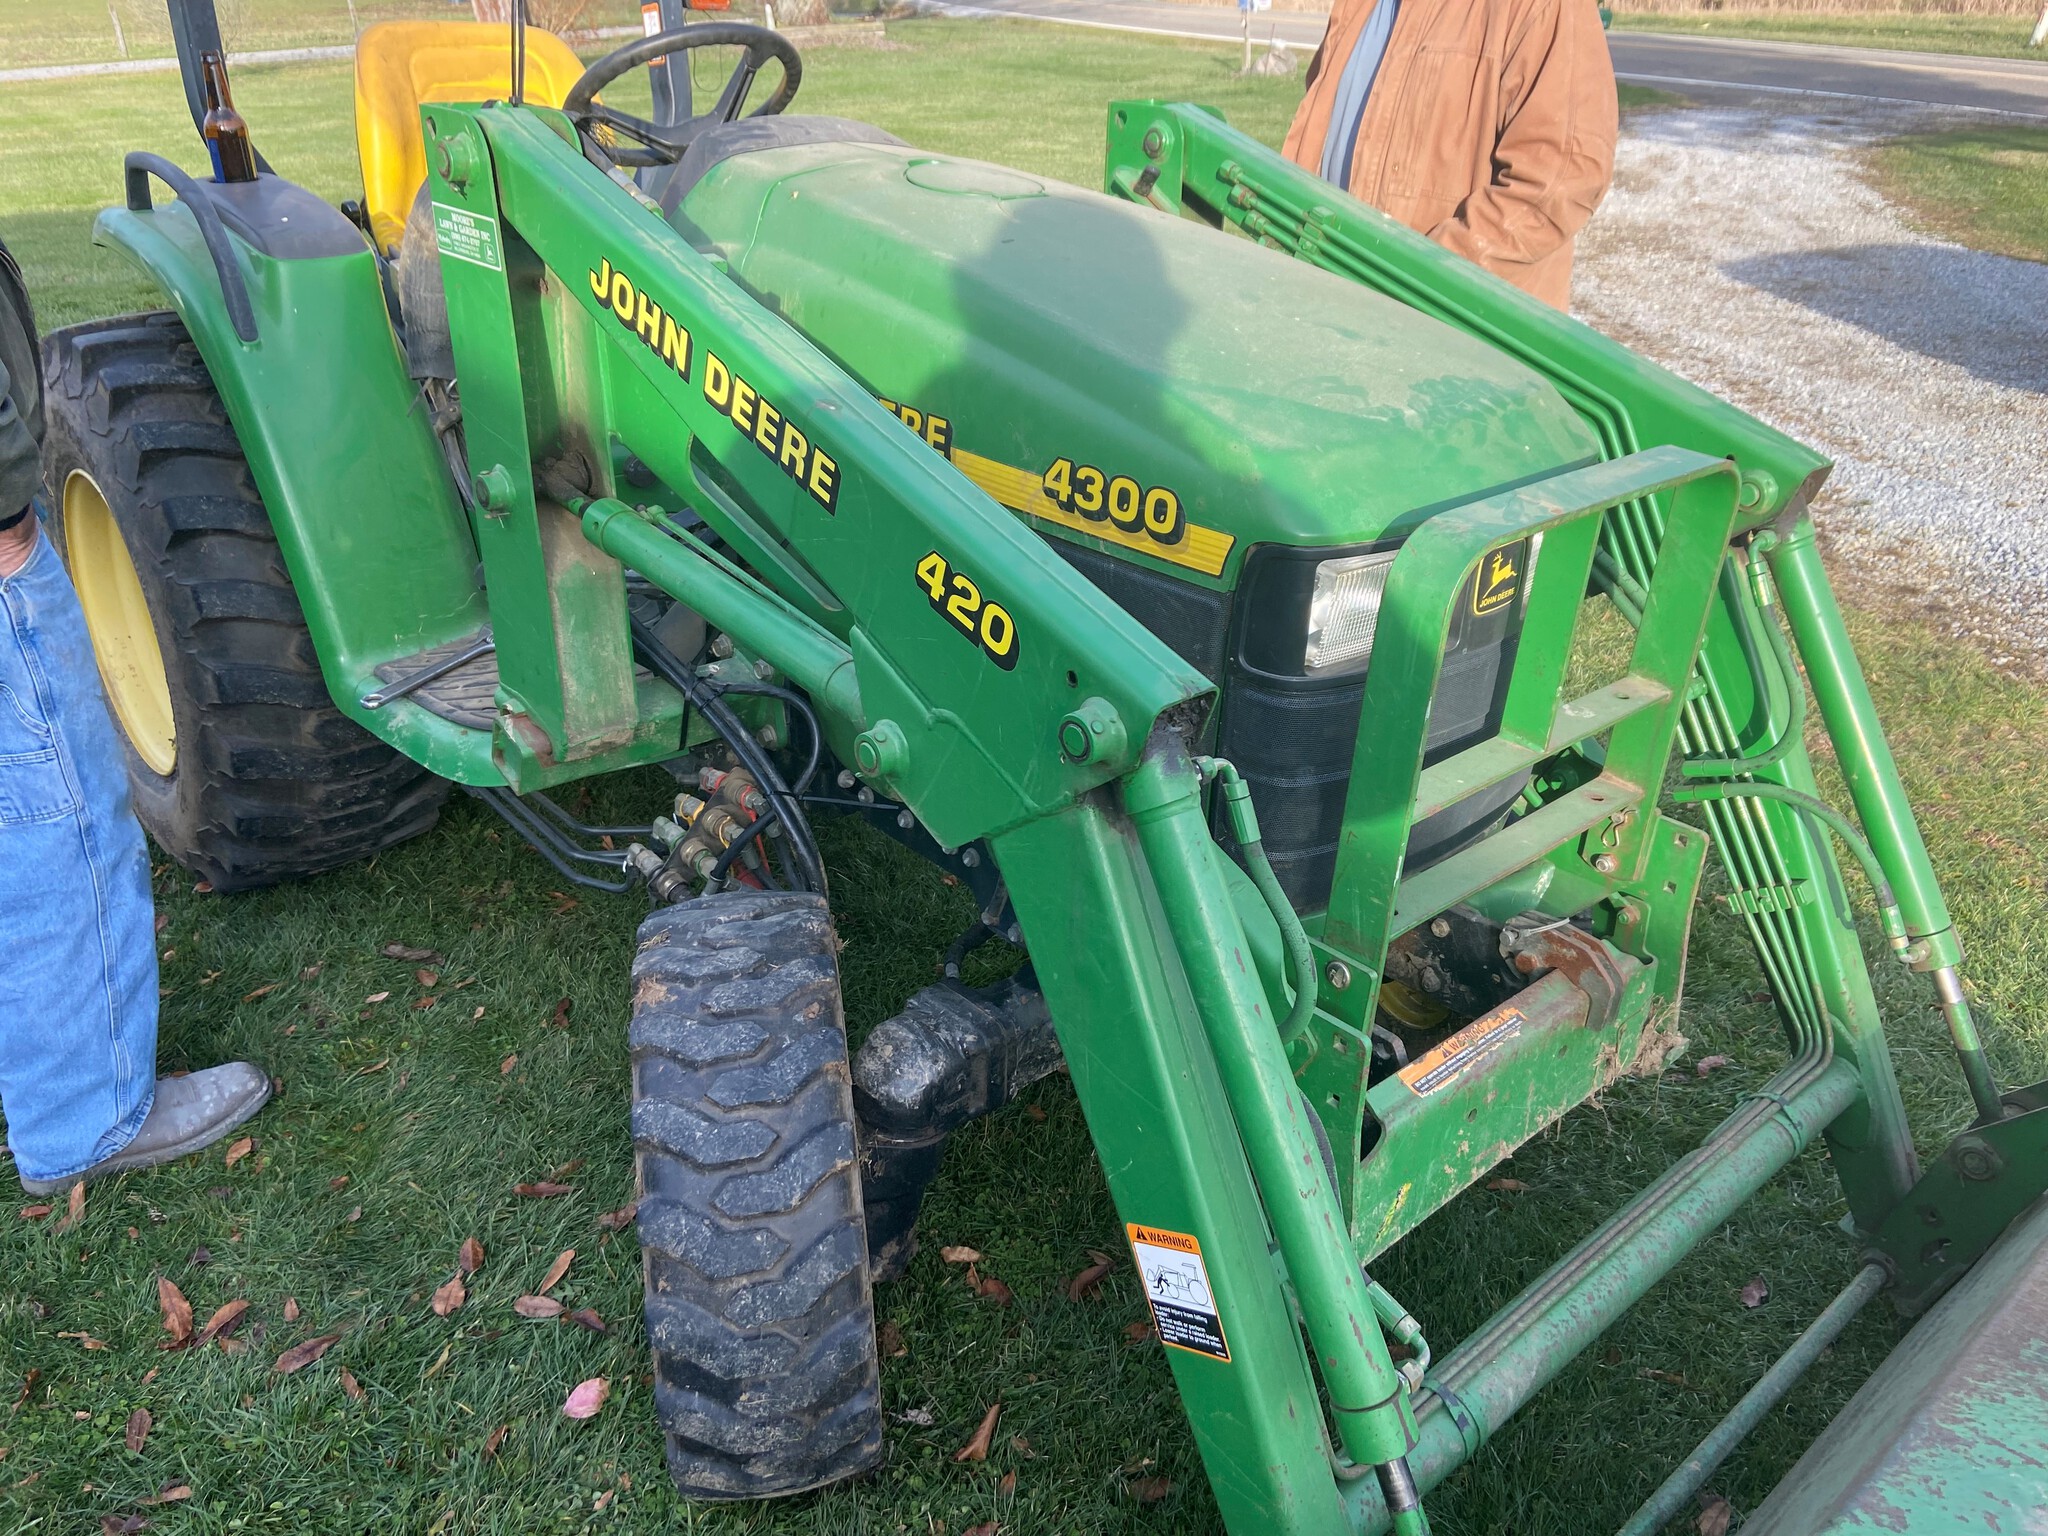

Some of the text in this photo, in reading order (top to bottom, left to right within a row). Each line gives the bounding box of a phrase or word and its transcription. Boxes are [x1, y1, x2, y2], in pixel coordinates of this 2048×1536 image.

[439, 218, 454, 230] LAWN
[459, 225, 480, 239] GARDEN
[589, 256, 840, 514] JOHN DEERE
[1043, 457, 1184, 544] 4300
[915, 550, 1019, 670] 420
[1480, 587, 1515, 608] JOHN DEERE
[1448, 1022, 1485, 1051] WRNING
[1147, 1231, 1192, 1249] WARNING
[1170, 1307, 1182, 1317] injury
[1194, 1314, 1208, 1324] falling
